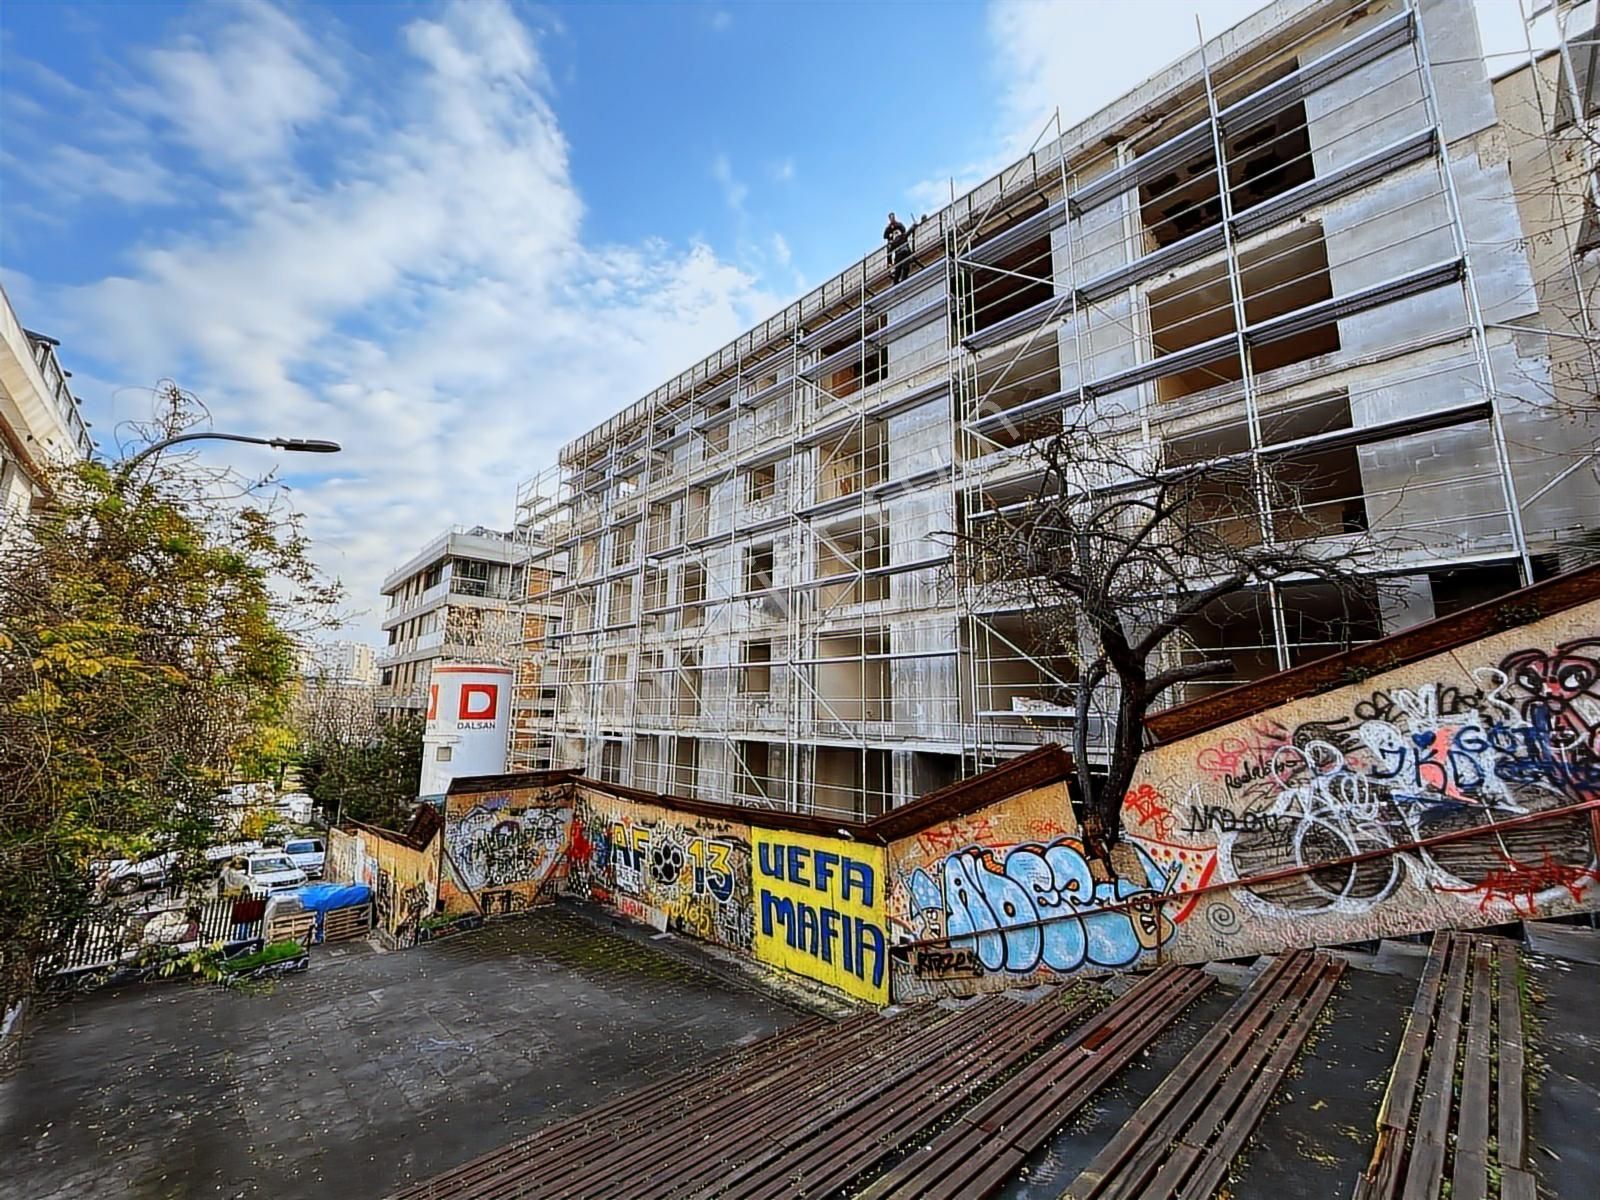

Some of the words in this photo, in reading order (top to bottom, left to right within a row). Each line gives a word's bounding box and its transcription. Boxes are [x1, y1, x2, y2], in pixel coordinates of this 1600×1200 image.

[457, 721, 496, 730] DALSAN
[759, 843, 875, 907] UEFA
[761, 890, 887, 989] MAFIA
